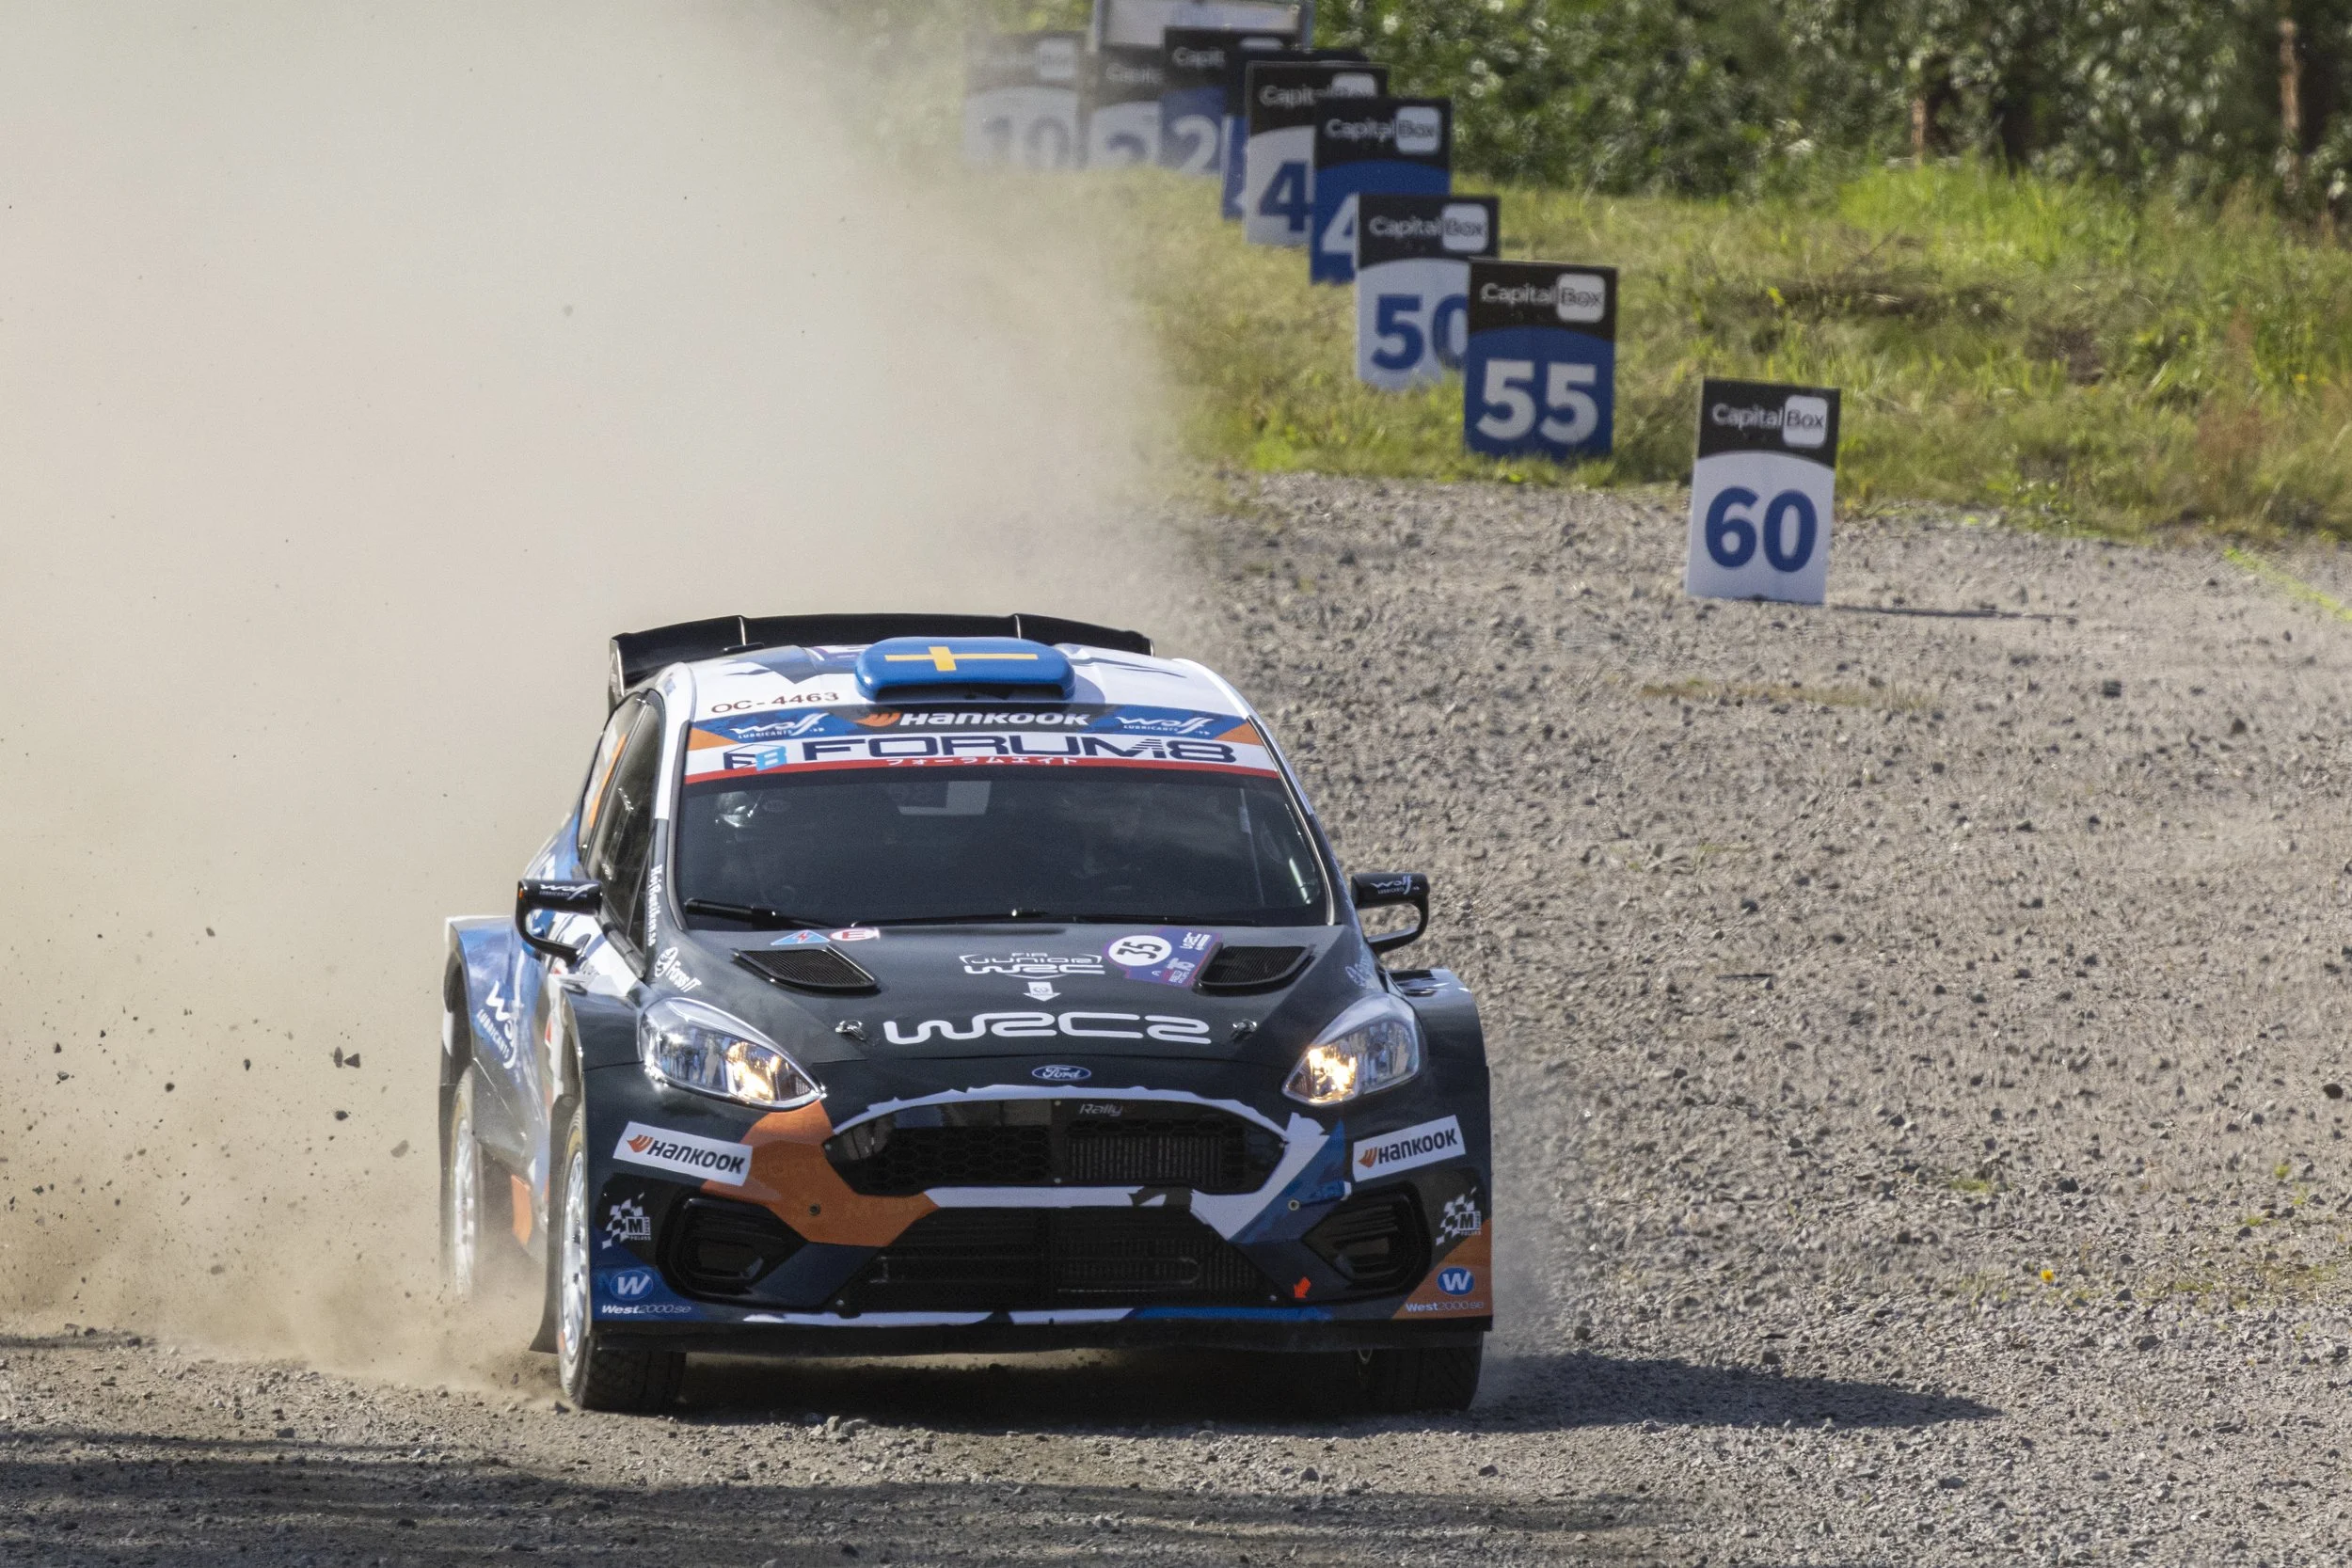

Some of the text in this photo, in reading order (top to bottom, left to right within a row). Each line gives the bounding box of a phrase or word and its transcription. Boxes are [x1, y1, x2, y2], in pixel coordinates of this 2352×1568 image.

[1173, 114, 1217, 173] 2
[1258, 161, 1311, 232] 4
[1480, 283, 1602, 307] CapitalBox
[1476, 357, 1598, 444] 55
[1711, 403, 1824, 430] CapitalBox
[1705, 485, 1818, 573] 60
[711, 692, 839, 713] OC-4463
[802, 736, 1236, 763] FORUM8
[886, 757, 1077, 766] フォーラムエイト
[1117, 942, 1163, 959] 35
[964, 964, 1105, 974] WRC
[882, 1011, 1212, 1045] WRC2
[1042, 1067, 1081, 1080] Ford
[1080, 1103, 1123, 1117] Rally
[617, 1275, 650, 1295] W
[1442, 1272, 1471, 1291] W
